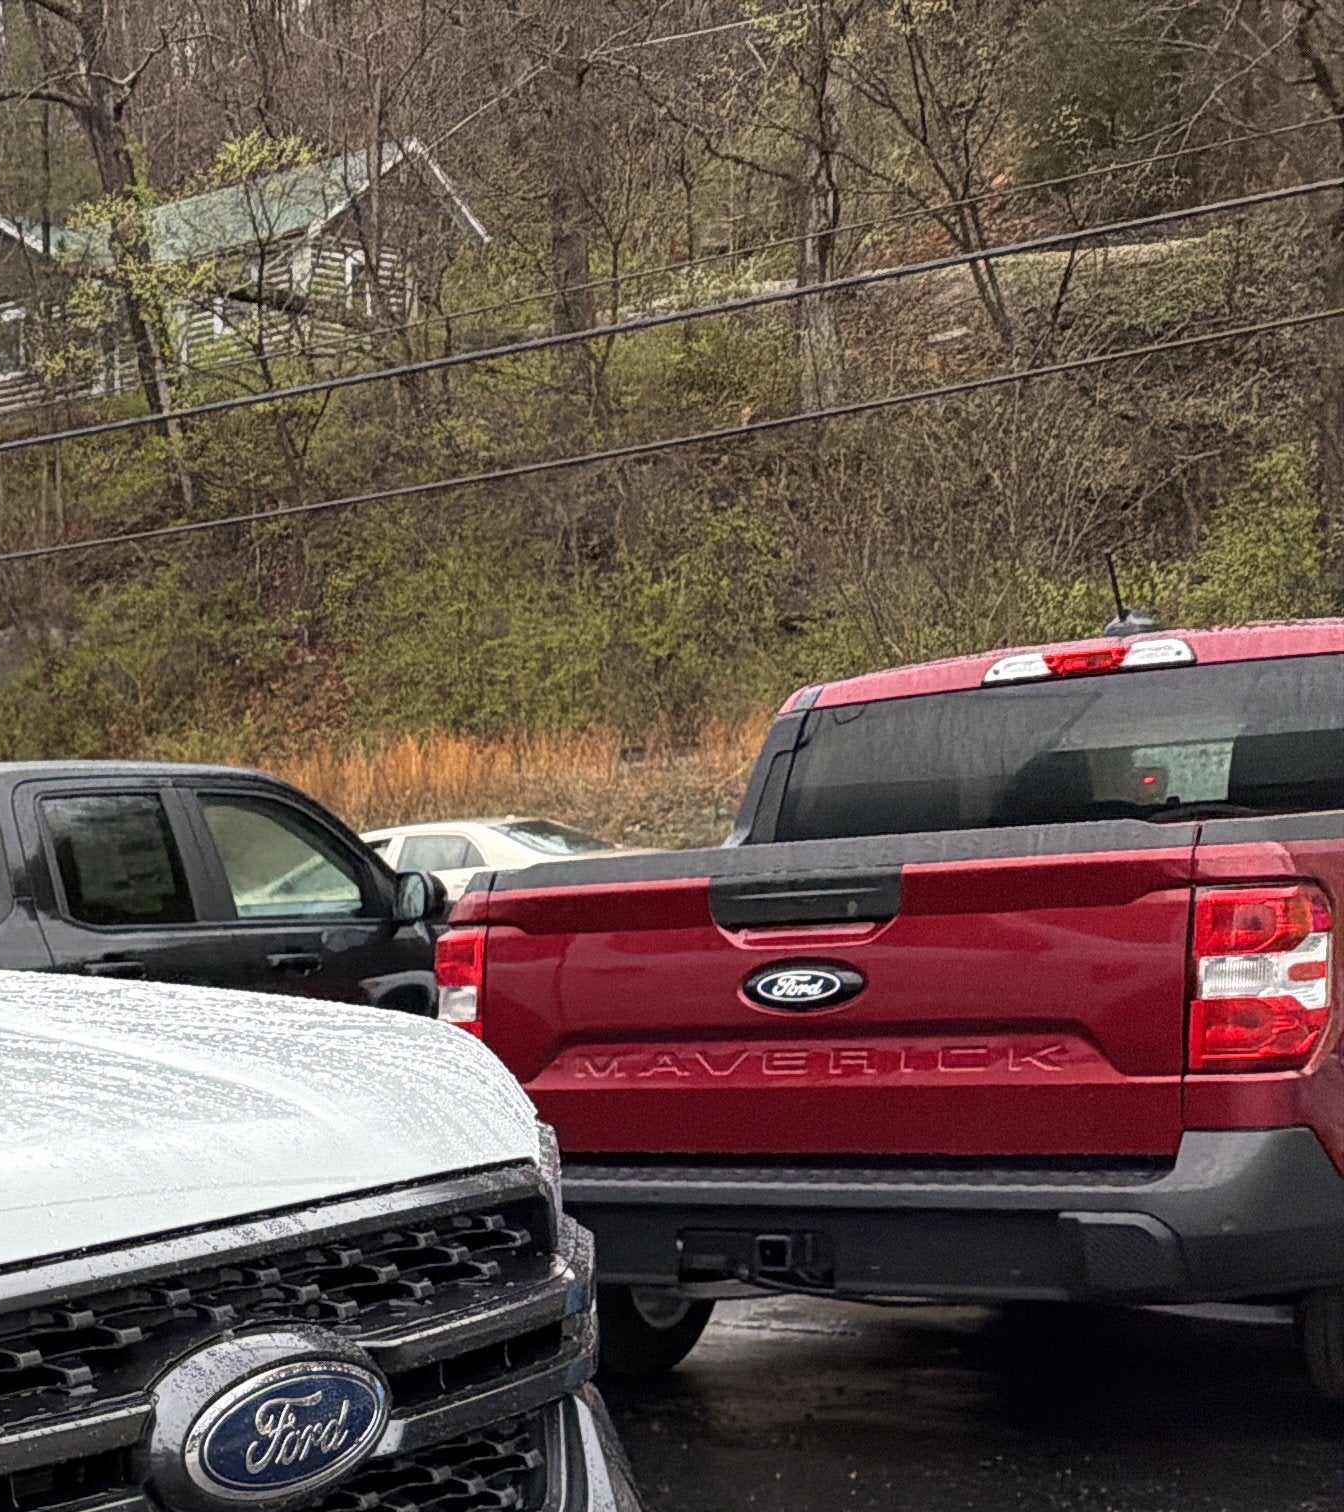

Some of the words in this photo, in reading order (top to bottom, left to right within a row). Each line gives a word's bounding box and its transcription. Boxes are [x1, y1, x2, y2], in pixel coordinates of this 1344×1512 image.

[773, 975, 824, 996] Ford
[574, 1045, 1065, 1078] MAVERICK
[246, 1391, 350, 1474] Ford
